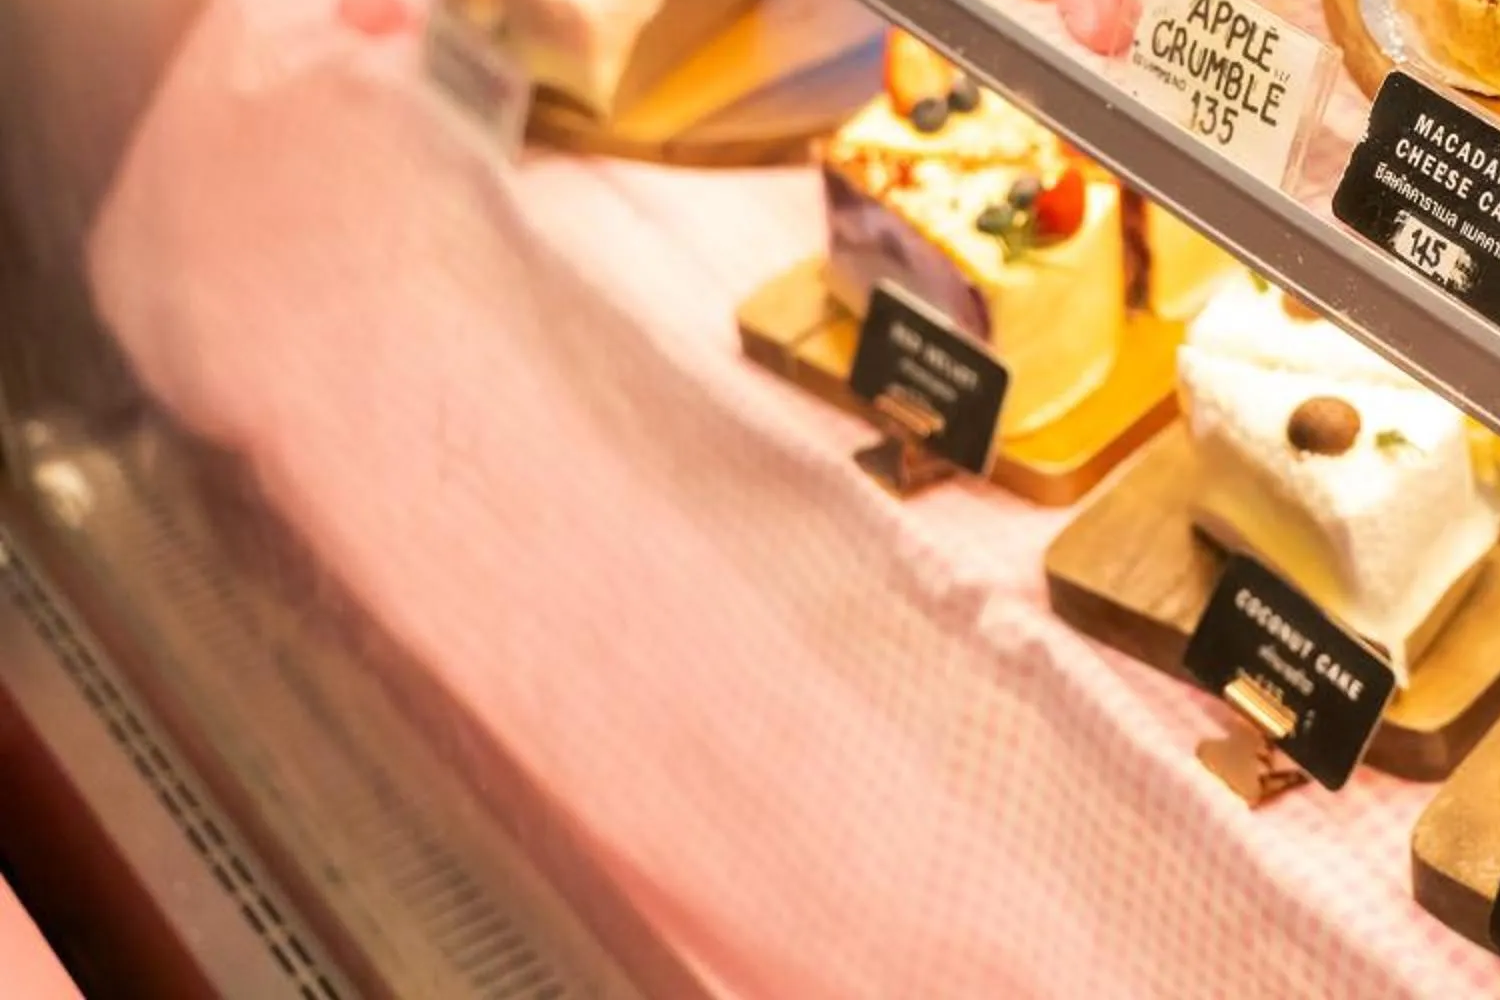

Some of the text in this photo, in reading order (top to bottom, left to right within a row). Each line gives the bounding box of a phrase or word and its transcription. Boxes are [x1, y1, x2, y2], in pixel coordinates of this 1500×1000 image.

[1151, 19, 1286, 127] CRUMBLE
[1190, 91, 1239, 145] 135
[1395, 139, 1473, 199] CHEESE
[1410, 227, 1447, 268] 145
[1234, 587, 1315, 659] COCONUT
[1314, 653, 1365, 701] CAKE
